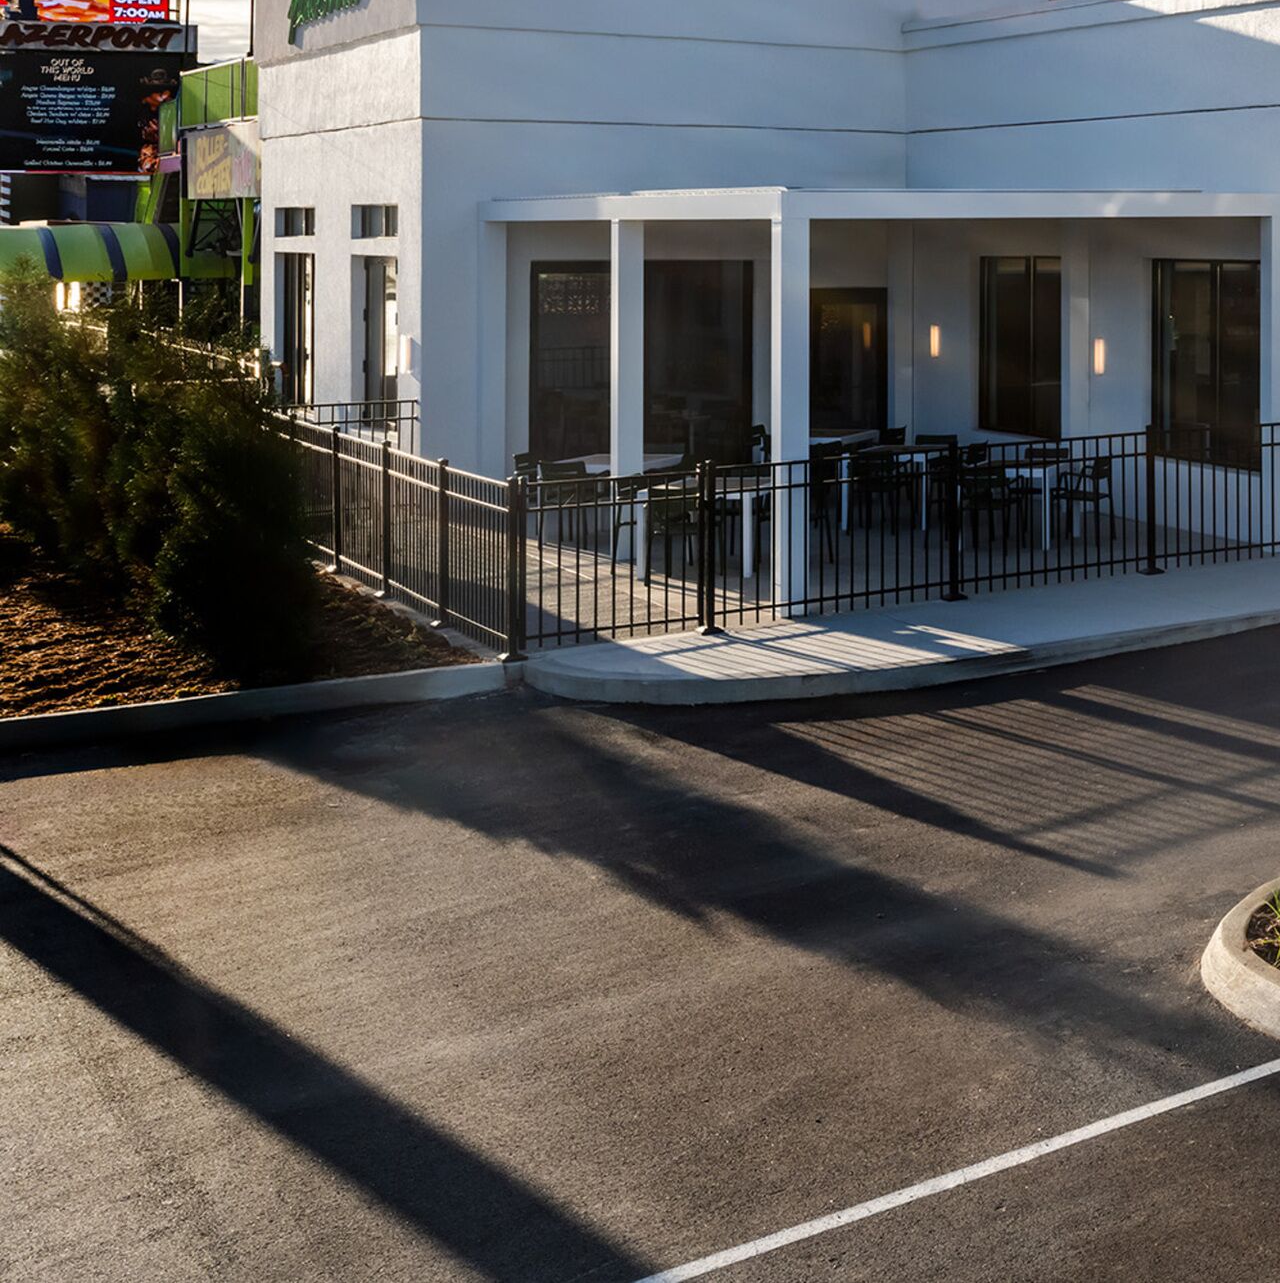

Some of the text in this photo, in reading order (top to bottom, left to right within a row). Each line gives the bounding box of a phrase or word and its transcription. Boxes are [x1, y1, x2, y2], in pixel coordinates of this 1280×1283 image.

[50, 58, 85, 67] OUT OF
[62, 66, 94, 75] WORLD
